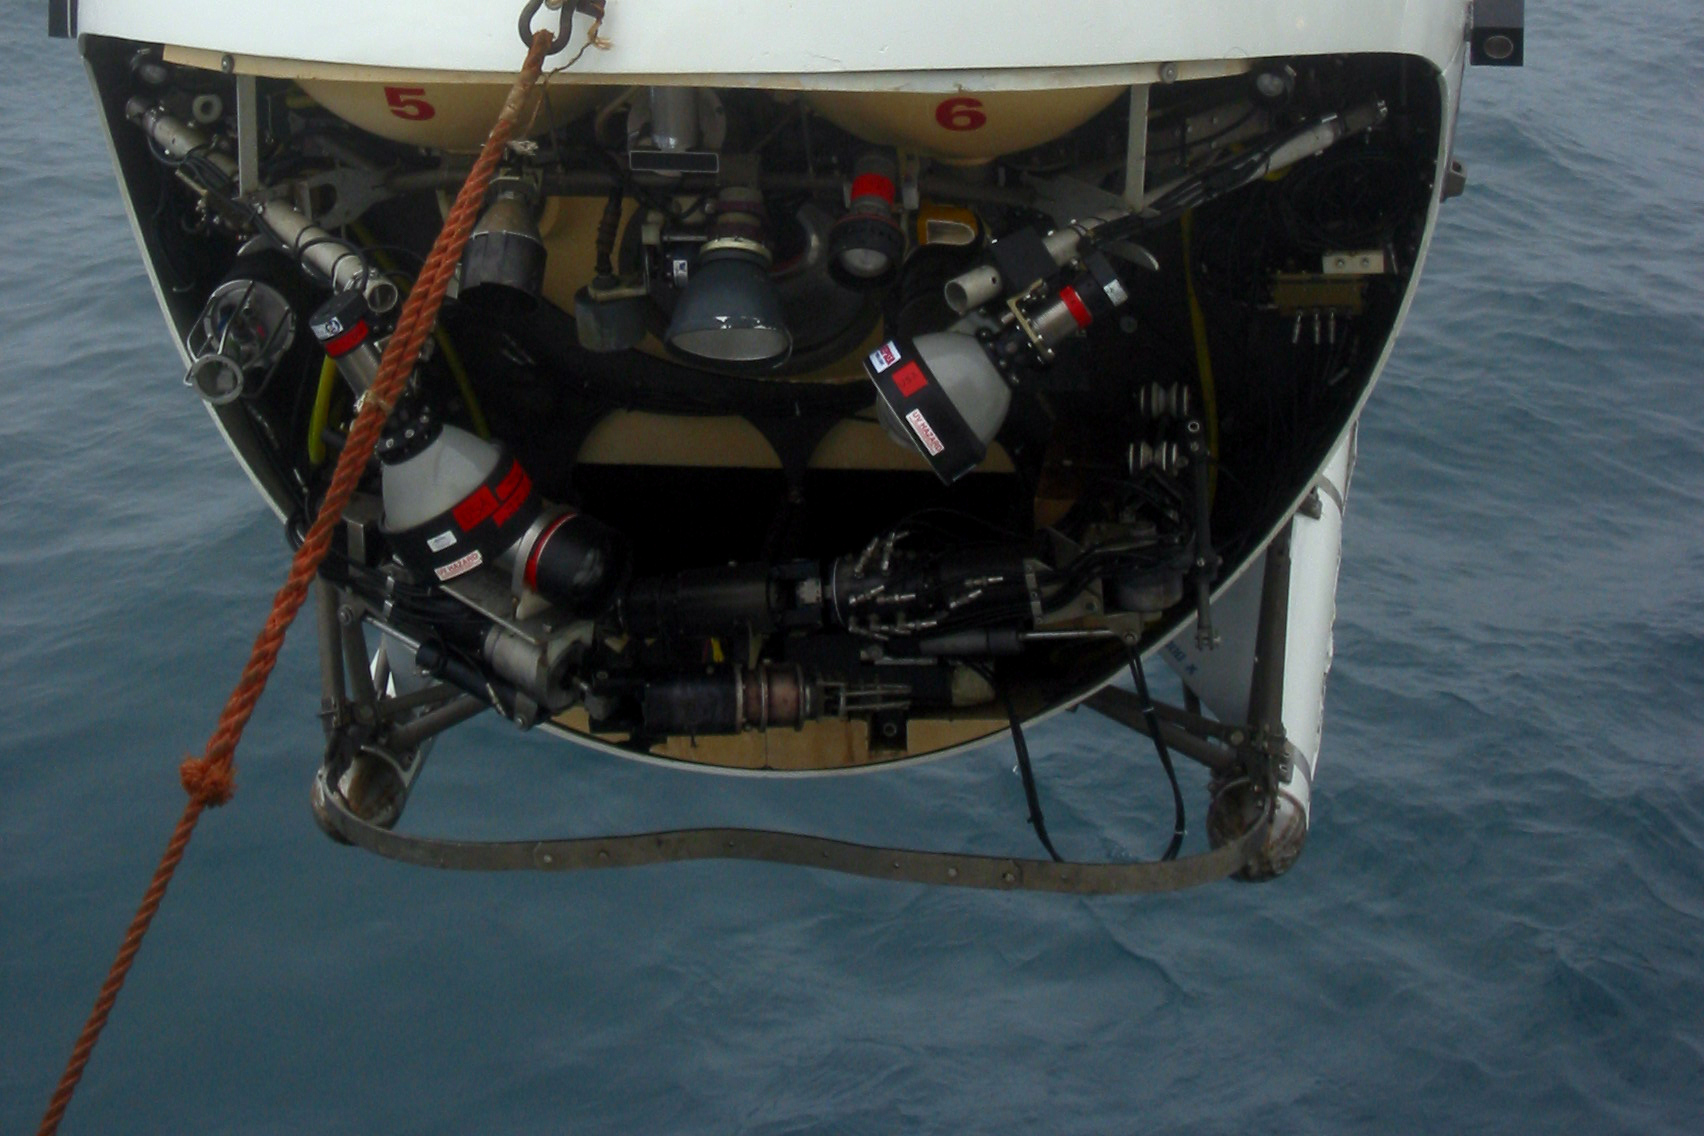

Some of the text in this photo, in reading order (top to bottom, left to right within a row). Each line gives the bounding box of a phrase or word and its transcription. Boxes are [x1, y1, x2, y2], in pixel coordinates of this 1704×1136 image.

[384, 87, 436, 121] 5
[935, 98, 987, 132] 6
[919, 422, 943, 451] HAZARD
[448, 552, 479, 572] HAZARD
